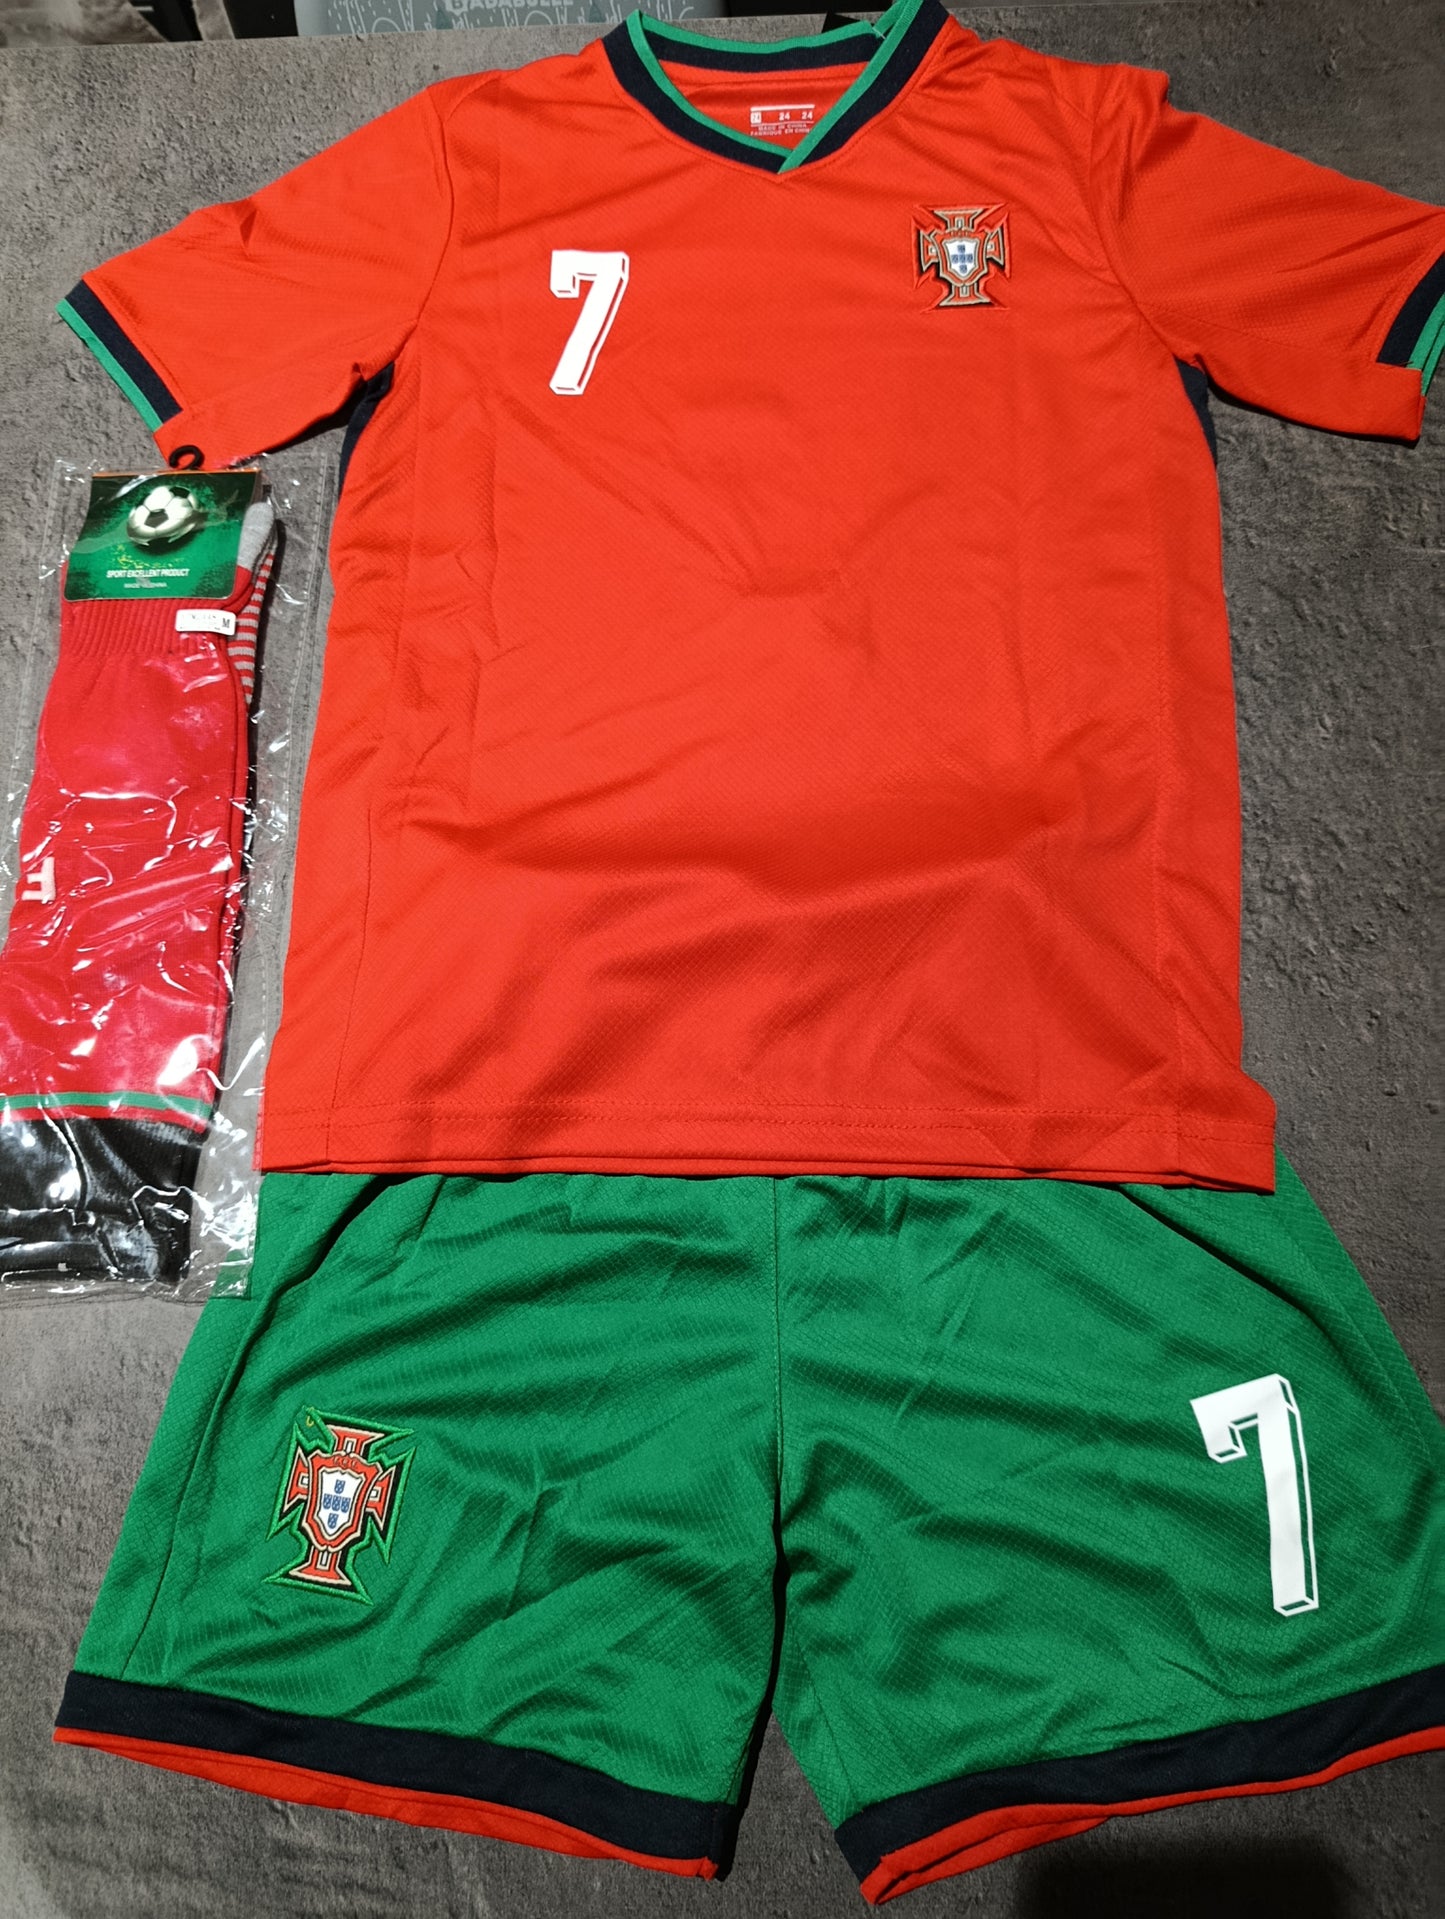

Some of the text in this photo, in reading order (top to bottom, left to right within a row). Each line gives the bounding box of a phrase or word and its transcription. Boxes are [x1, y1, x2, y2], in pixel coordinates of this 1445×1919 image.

[779, 112, 790, 121] 24
[801, 111, 813, 120] 24
[549, 249, 630, 395] 7
[106, 568, 190, 578] SPORT EXCELLENT PRODUCT
[221, 617, 230, 628] M
[1190, 1373, 1319, 1617] 7
